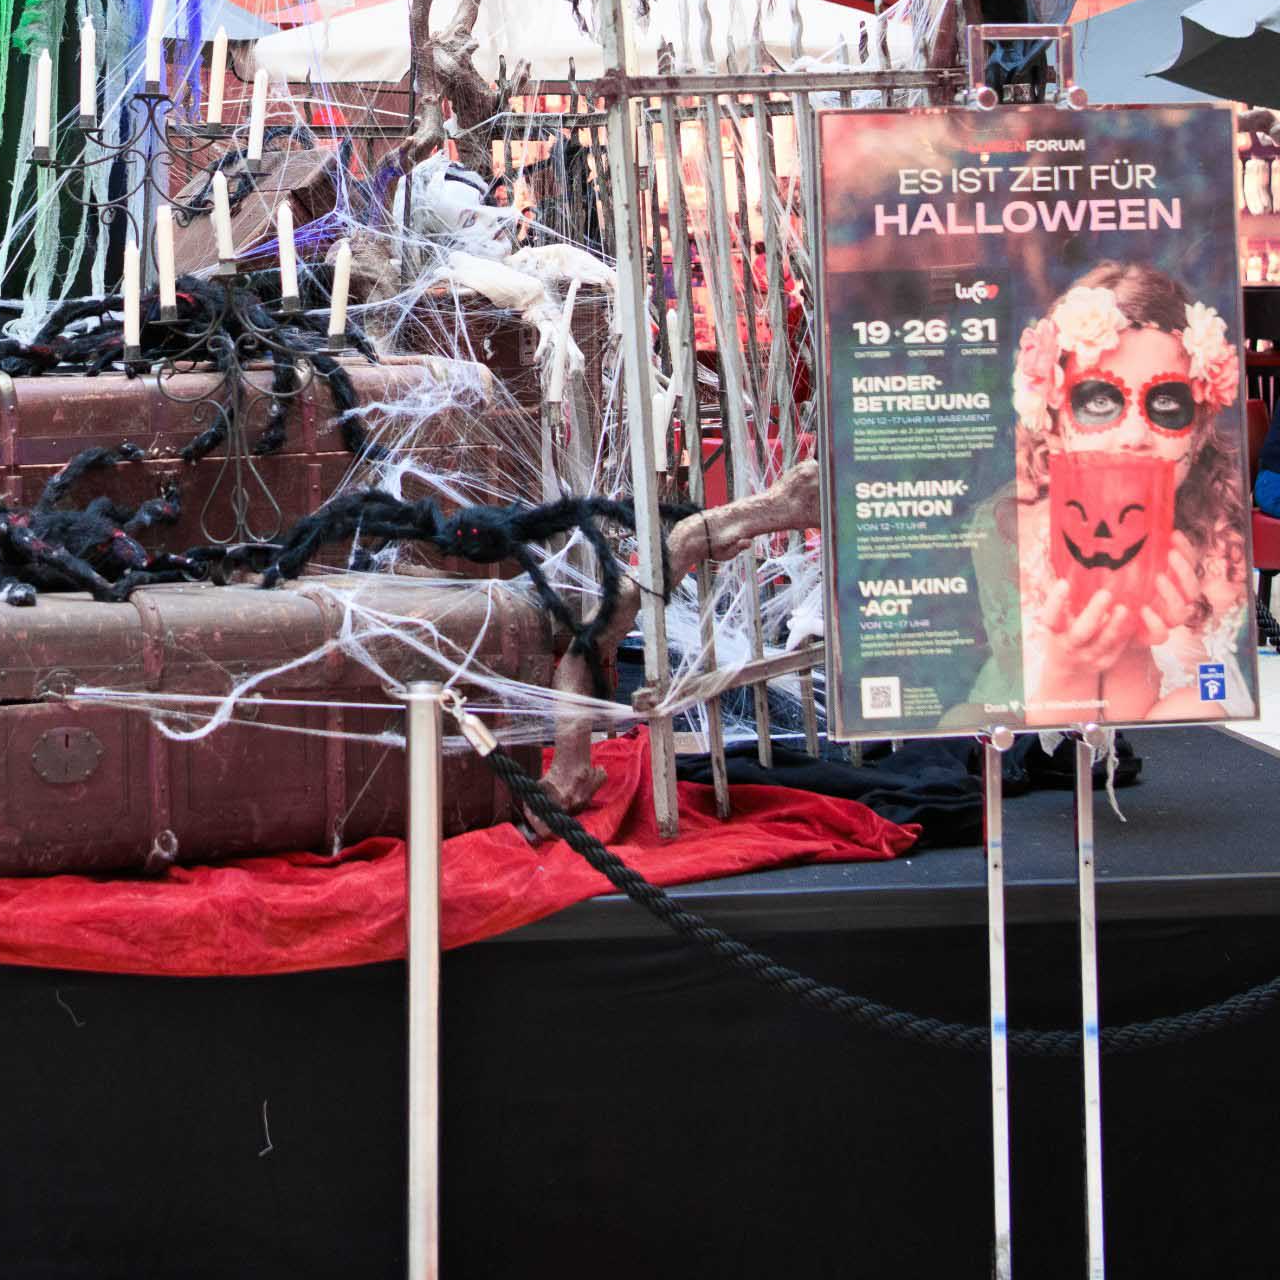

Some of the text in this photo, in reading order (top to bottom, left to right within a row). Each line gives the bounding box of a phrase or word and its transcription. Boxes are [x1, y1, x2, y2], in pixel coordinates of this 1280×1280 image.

[898, 158, 1157, 195] ES IST ZEIT FÜR
[874, 198, 1183, 237] HALLOWEEN
[852, 317, 997, 345] 19 26 31
[852, 375, 943, 394] KINDER-
[852, 392, 990, 413] BETREUUNG
[855, 479, 969, 499] SCHMINK-
[855, 499, 953, 518] STATION
[859, 576, 968, 597] WALKING
